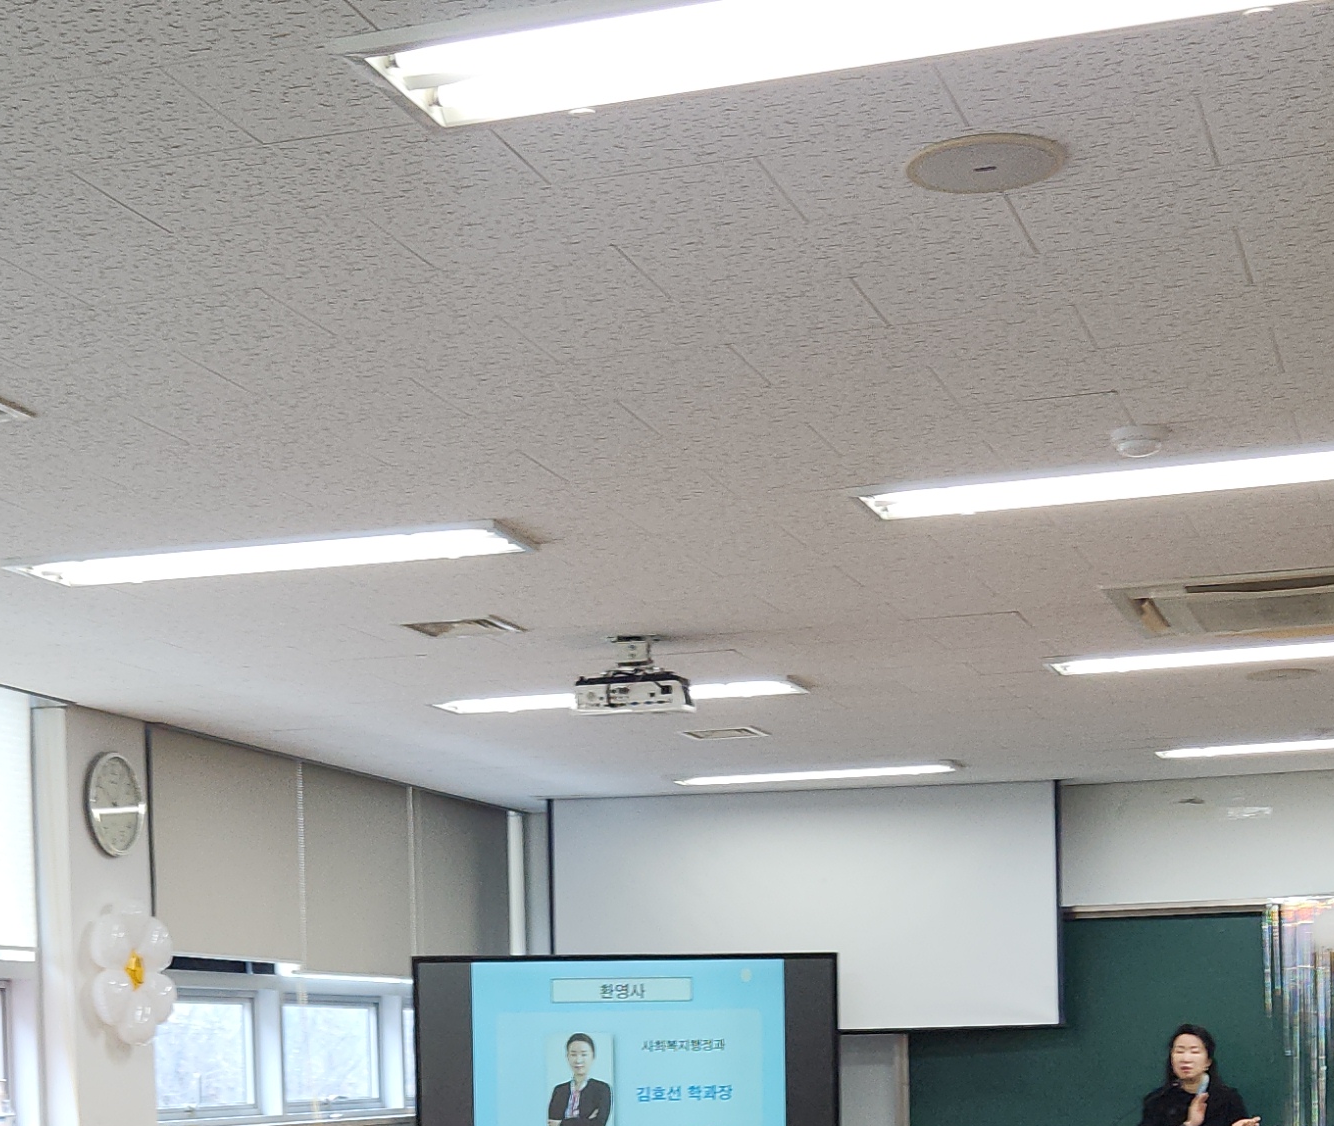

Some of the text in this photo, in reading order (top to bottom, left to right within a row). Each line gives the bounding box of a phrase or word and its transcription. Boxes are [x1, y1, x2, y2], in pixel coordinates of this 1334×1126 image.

[599, 983, 646, 1000] 환영사
[641, 1038, 726, 1053] 사회복지행정과
[636, 1084, 733, 1103] 김호선 학과장
